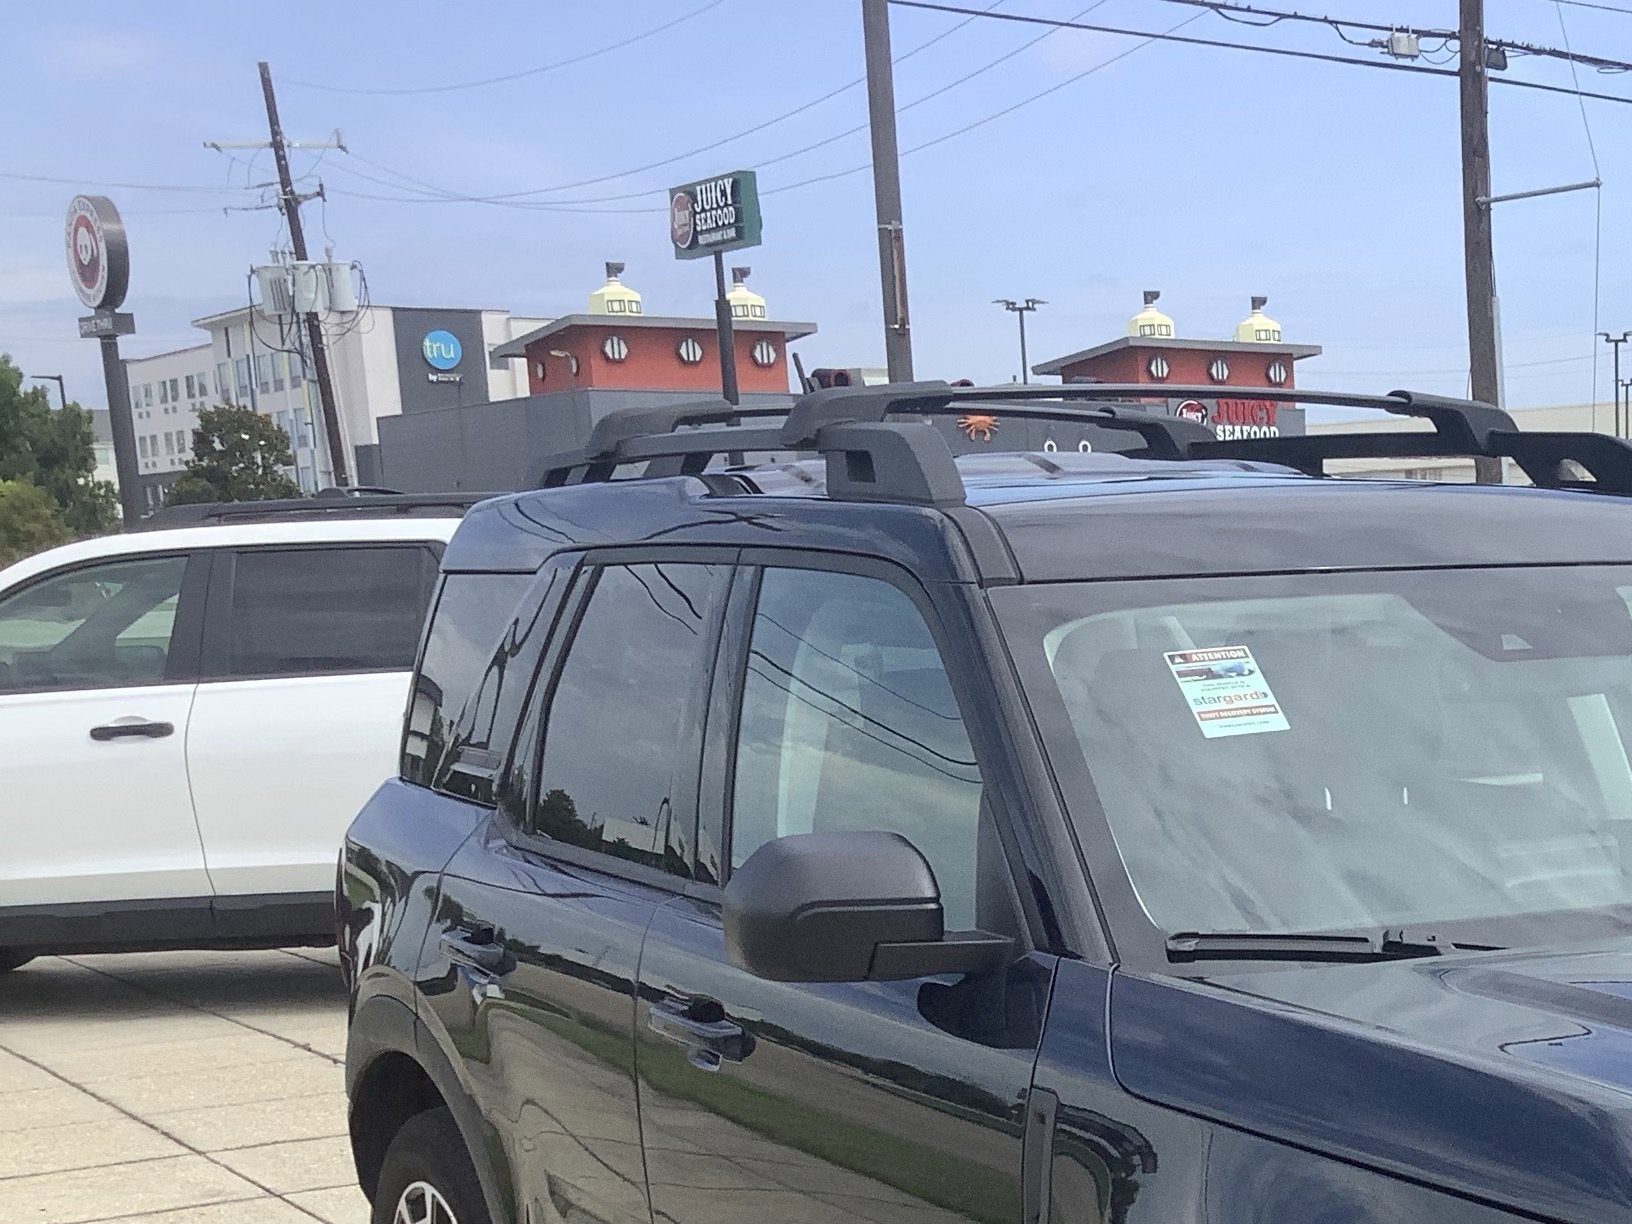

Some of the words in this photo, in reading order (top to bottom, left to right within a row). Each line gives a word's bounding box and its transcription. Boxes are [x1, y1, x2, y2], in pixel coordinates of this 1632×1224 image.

[694, 178, 733, 213] JUICY
[695, 206, 735, 231] SEAFOOD
[423, 337, 455, 359] tru
[1211, 398, 1278, 426] JUICY
[1216, 425, 1280, 441] SEAFOOD
[1192, 650, 1245, 661] ATTENTION
[1193, 691, 1259, 706] stargard
